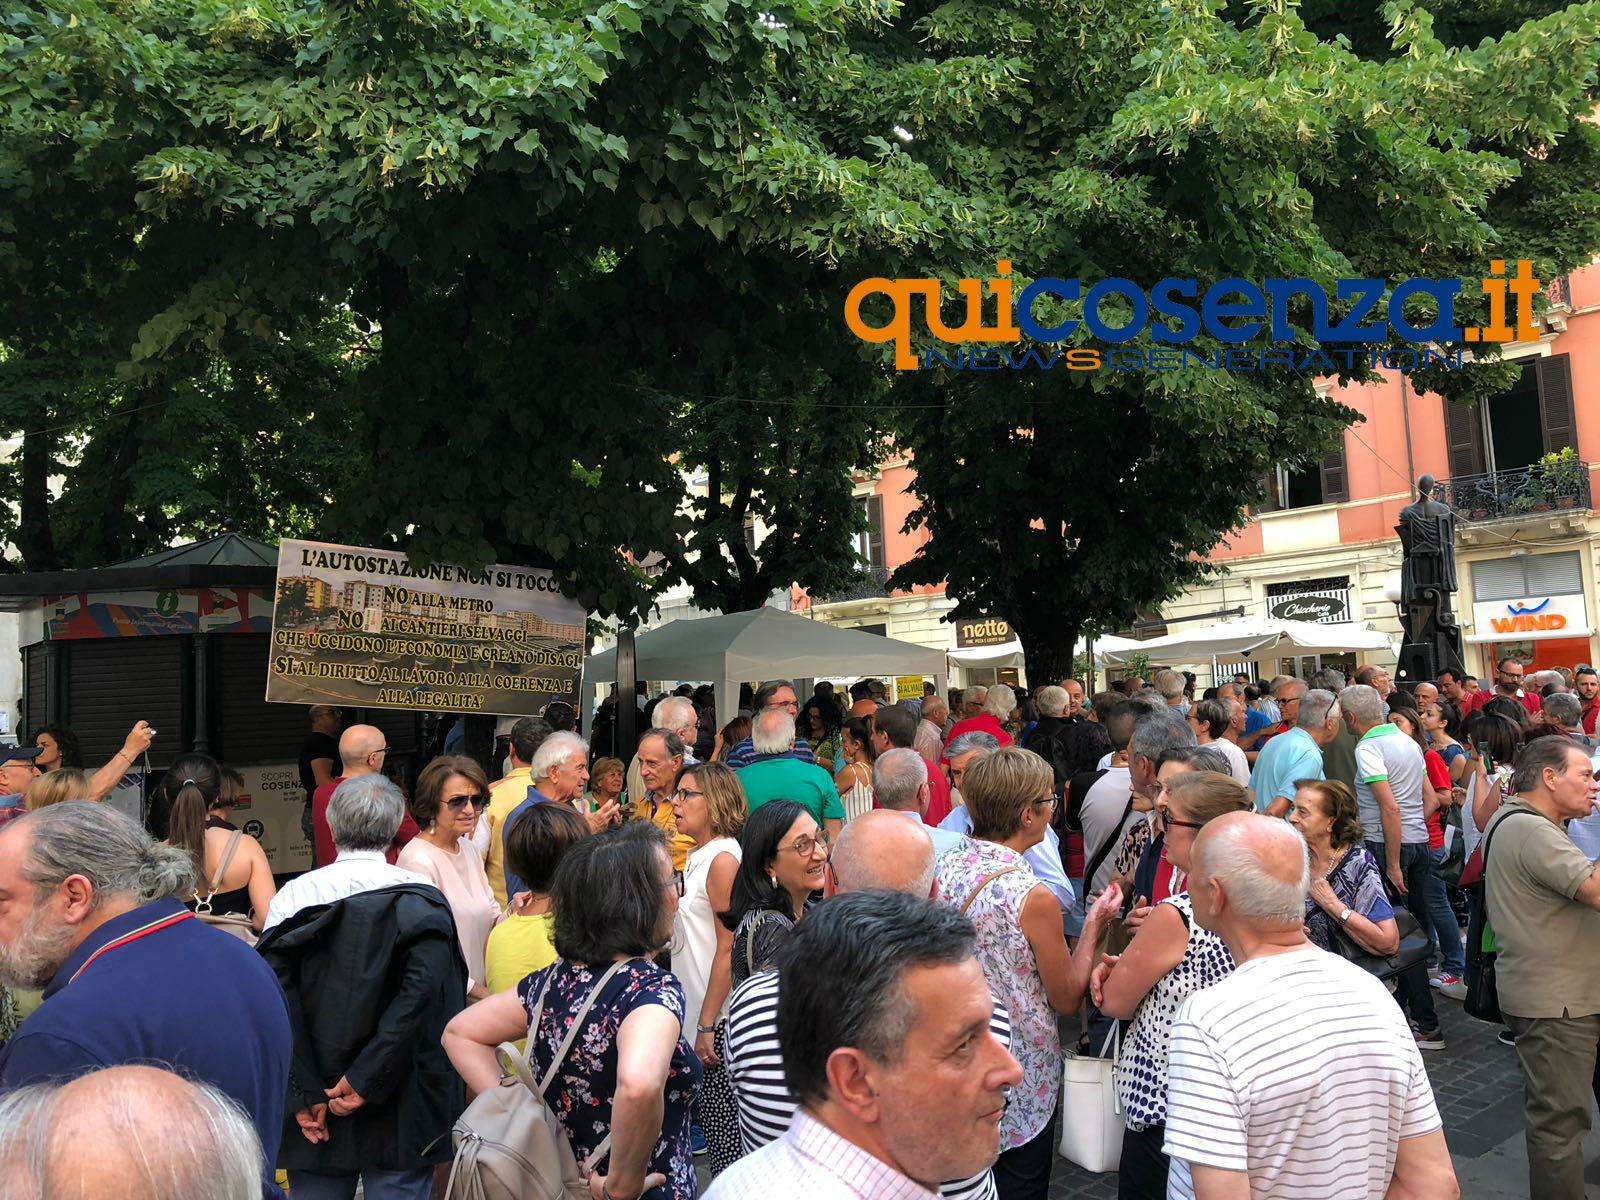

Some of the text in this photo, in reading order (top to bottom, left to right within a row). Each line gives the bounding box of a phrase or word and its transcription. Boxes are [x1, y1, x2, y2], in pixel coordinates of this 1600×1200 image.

[496, 571, 512, 588] SI
[515, 573, 561, 593] TOCC
[383, 586, 494, 613] NO ALLA METRO
[337, 609, 528, 642] NO AI CANTIERI SELVAGGI
[1490, 614, 1567, 633] WIND
[275, 630, 580, 668] CHE UCCIDONO L'ECONOMIA E CREANO DISAGI
[275, 656, 573, 693] SI AL DIRITTO AL LAVORO ALLA COERENZA E
[376, 688, 484, 709] ALLA LEGALITA'
[261, 771, 294, 781] SCOPRI
[261, 780, 304, 791] COSENZ
